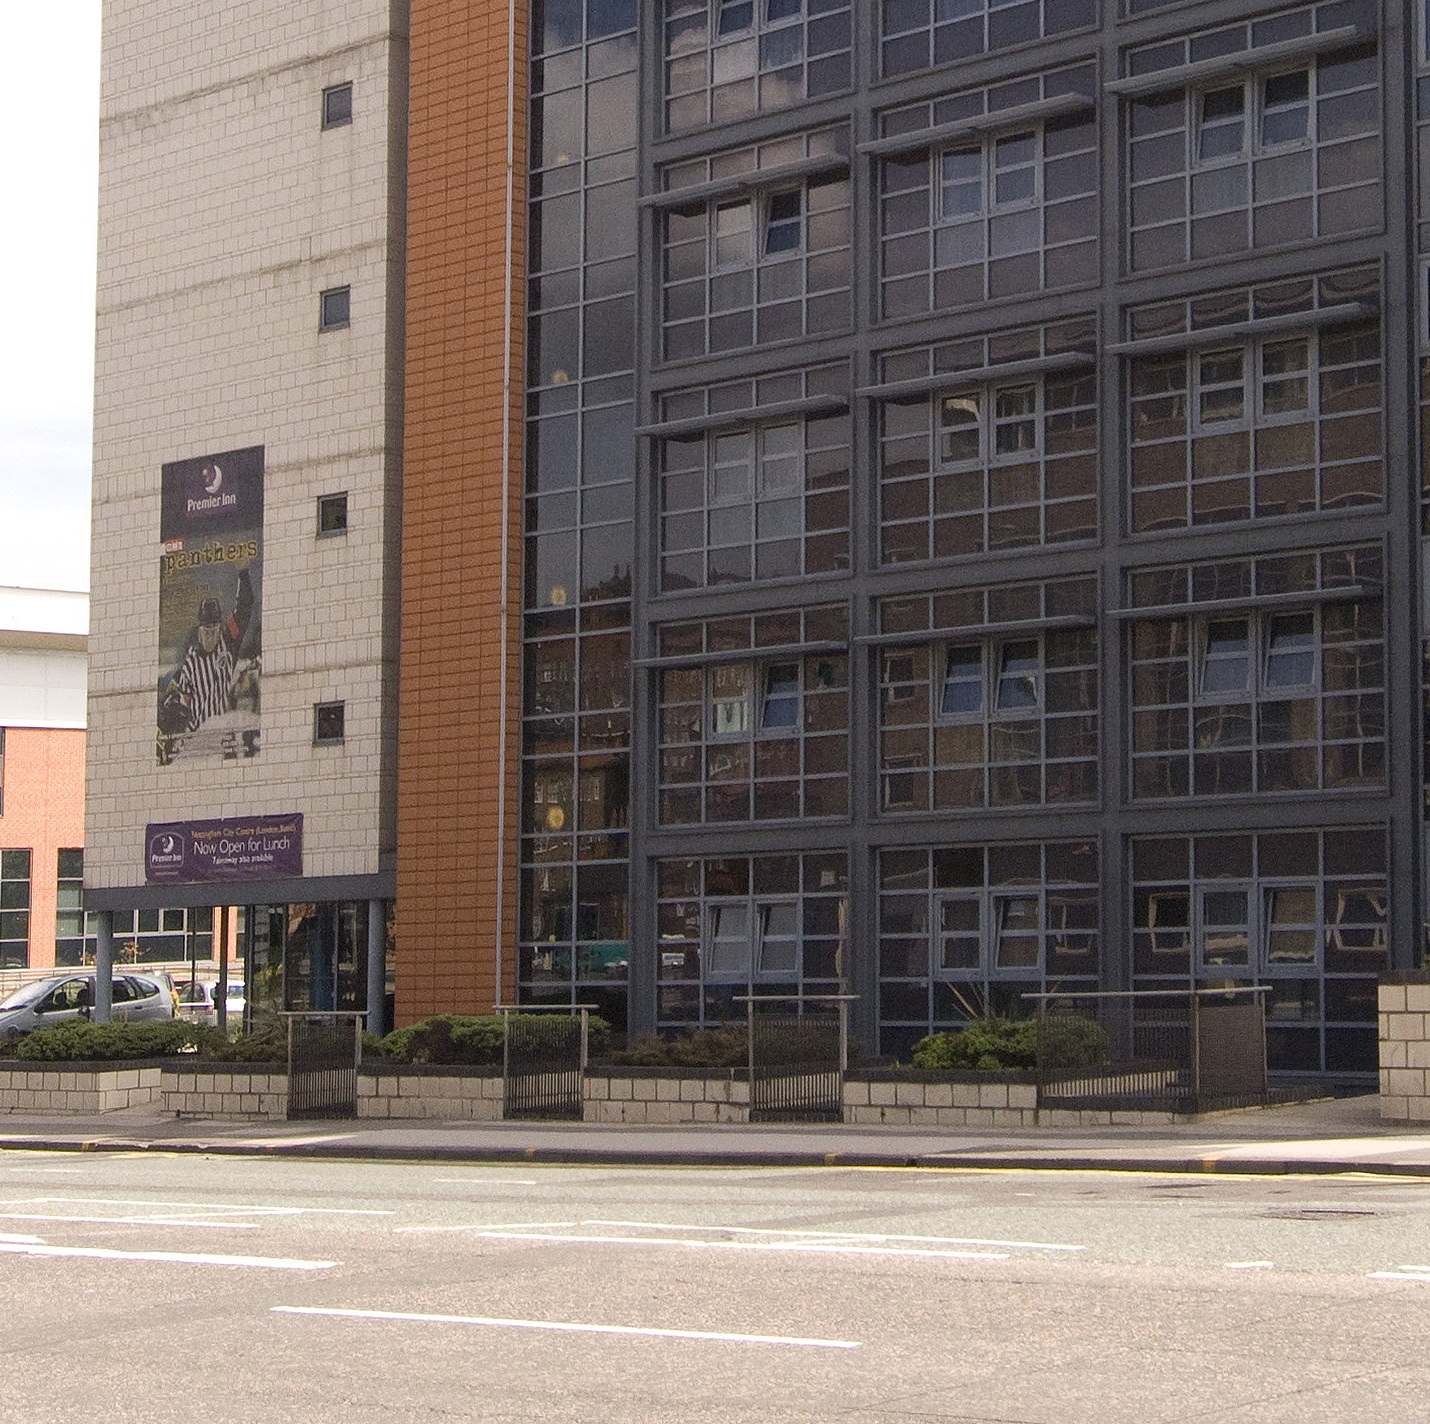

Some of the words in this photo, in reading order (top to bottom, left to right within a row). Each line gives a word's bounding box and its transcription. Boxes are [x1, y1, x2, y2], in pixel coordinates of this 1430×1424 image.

[187, 495, 221, 512] Premier
[222, 493, 237, 506] Inn
[163, 540, 258, 575] panthers
[193, 840, 217, 855] Now
[219, 839, 245, 856] Open
[247, 836, 262, 851] for
[263, 835, 290, 851] Lunch
